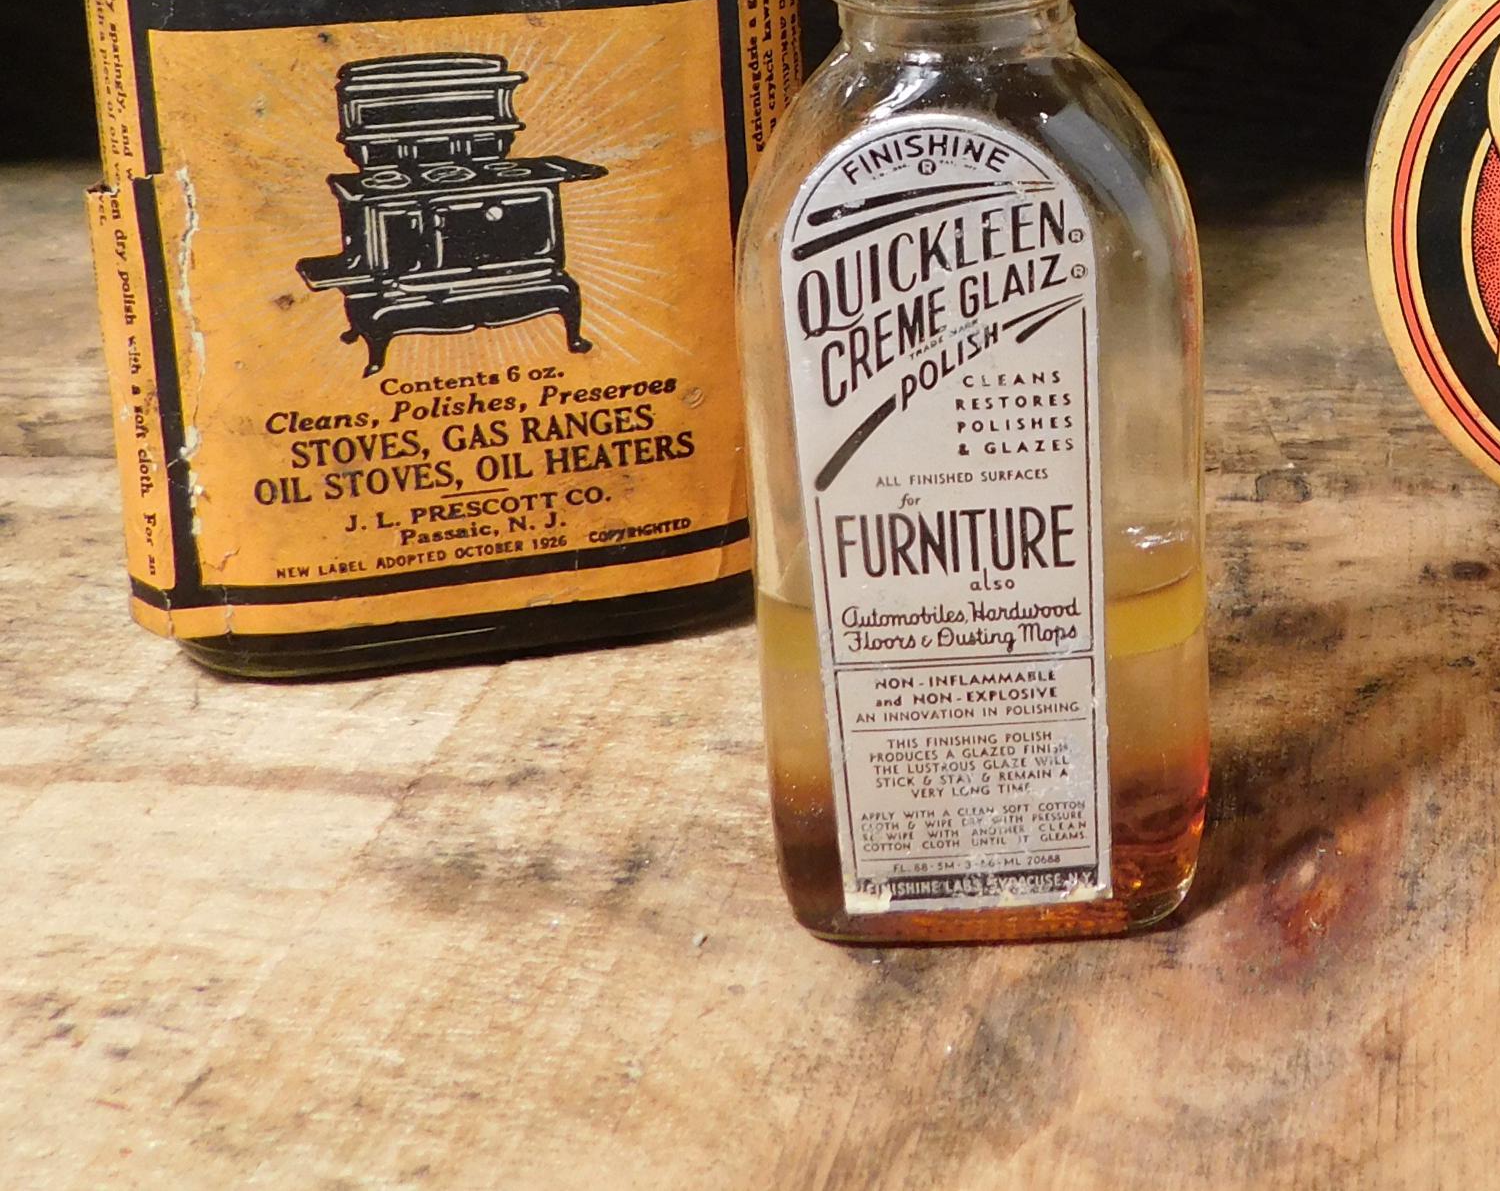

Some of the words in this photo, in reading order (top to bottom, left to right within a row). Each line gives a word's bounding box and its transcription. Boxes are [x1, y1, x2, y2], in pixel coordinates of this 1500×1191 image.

[749, 17, 756, 27] a
[108, 22, 128, 114] sparingly,
[121, 123, 134, 159] and
[750, 36, 764, 152] gdzieniegdzie
[841, 134, 1010, 185] FINISHINE
[114, 229, 128, 261] dry
[798, 199, 1065, 340] QUICKLEEN
[117, 270, 137, 326] polish
[820, 286, 946, 408] CREME
[959, 254, 1067, 319] GLAIZ
[127, 336, 141, 376] with
[901, 322, 999, 412] POLISH
[131, 383, 141, 396] a
[380, 370, 500, 396] Contents
[507, 366, 520, 381] 6
[528, 366, 565, 380] oz.
[963, 370, 1061, 388] CLEANS
[265, 410, 380, 436] Cleans,
[390, 393, 527, 424] Polishes,
[539, 377, 678, 407] Preserves
[955, 393, 1072, 411] RESTORES
[133, 405, 147, 440] soft
[291, 428, 430, 470] STOVES,
[442, 419, 511, 451] GAS
[521, 404, 655, 444] RANGES
[957, 416, 1073, 434] POLISHES
[958, 443, 970, 455] &
[985, 438, 1075, 454] GLAZES
[253, 477, 311, 506] OIL
[324, 460, 464, 501] STOVES,
[476, 453, 533, 483] OIL
[546, 430, 696, 475] HEATERS
[876, 476, 899, 488] ALL
[909, 471, 974, 484] FINISHED
[981, 468, 1049, 481] SURFACES
[344, 513, 367, 533] J.
[376, 509, 401, 530] L.
[411, 492, 558, 526] PRESCOTT
[566, 485, 612, 506] CO.
[899, 494, 921, 510] for
[143, 512, 157, 547] For
[400, 522, 501, 547] Passaic,
[509, 514, 538, 533] N.
[545, 510, 567, 529] J.
[834, 504, 1076, 579] FURNITURE
[276, 565, 310, 580] NEW
[318, 560, 367, 577] LABEL
[376, 549, 446, 570] ADOPTED
[455, 538, 523, 560] OCTOBER
[532, 534, 568, 550] 1926
[588, 516, 692, 544] COPYRIGHTED
[149, 553, 156, 576] an
[969, 568, 1015, 591] also
[841, 604, 969, 628] Automobiles,
[969, 598, 1081, 621] Hardwood
[842, 629, 917, 652] Floors
[921, 635, 932, 647] &
[937, 627, 1016, 653] Dusting
[1018, 621, 1078, 647] Mops
[856, 713, 876, 724] AN
[883, 707, 975, 723] INNOVATION
[982, 706, 998, 717] IN
[1006, 701, 1080, 716] POLISHING
[875, 695, 902, 708] and
[869, 750, 938, 763] PRODUCES
[946, 748, 955, 759] A
[962, 746, 1015, 758] GLAZED
[887, 738, 918, 749] THIS
[926, 734, 998, 747] FINISHING
[1005, 731, 1052, 744] POLISH
[873, 764, 899, 776] THE
[907, 760, 976, 774] LUSTROUS
[983, 758, 1026, 770] GLAZE
[875, 777, 915, 789] STICK
[999, 769, 1052, 781] REMAIN
[911, 787, 944, 799] VERY
[952, 786, 991, 797] LONG
